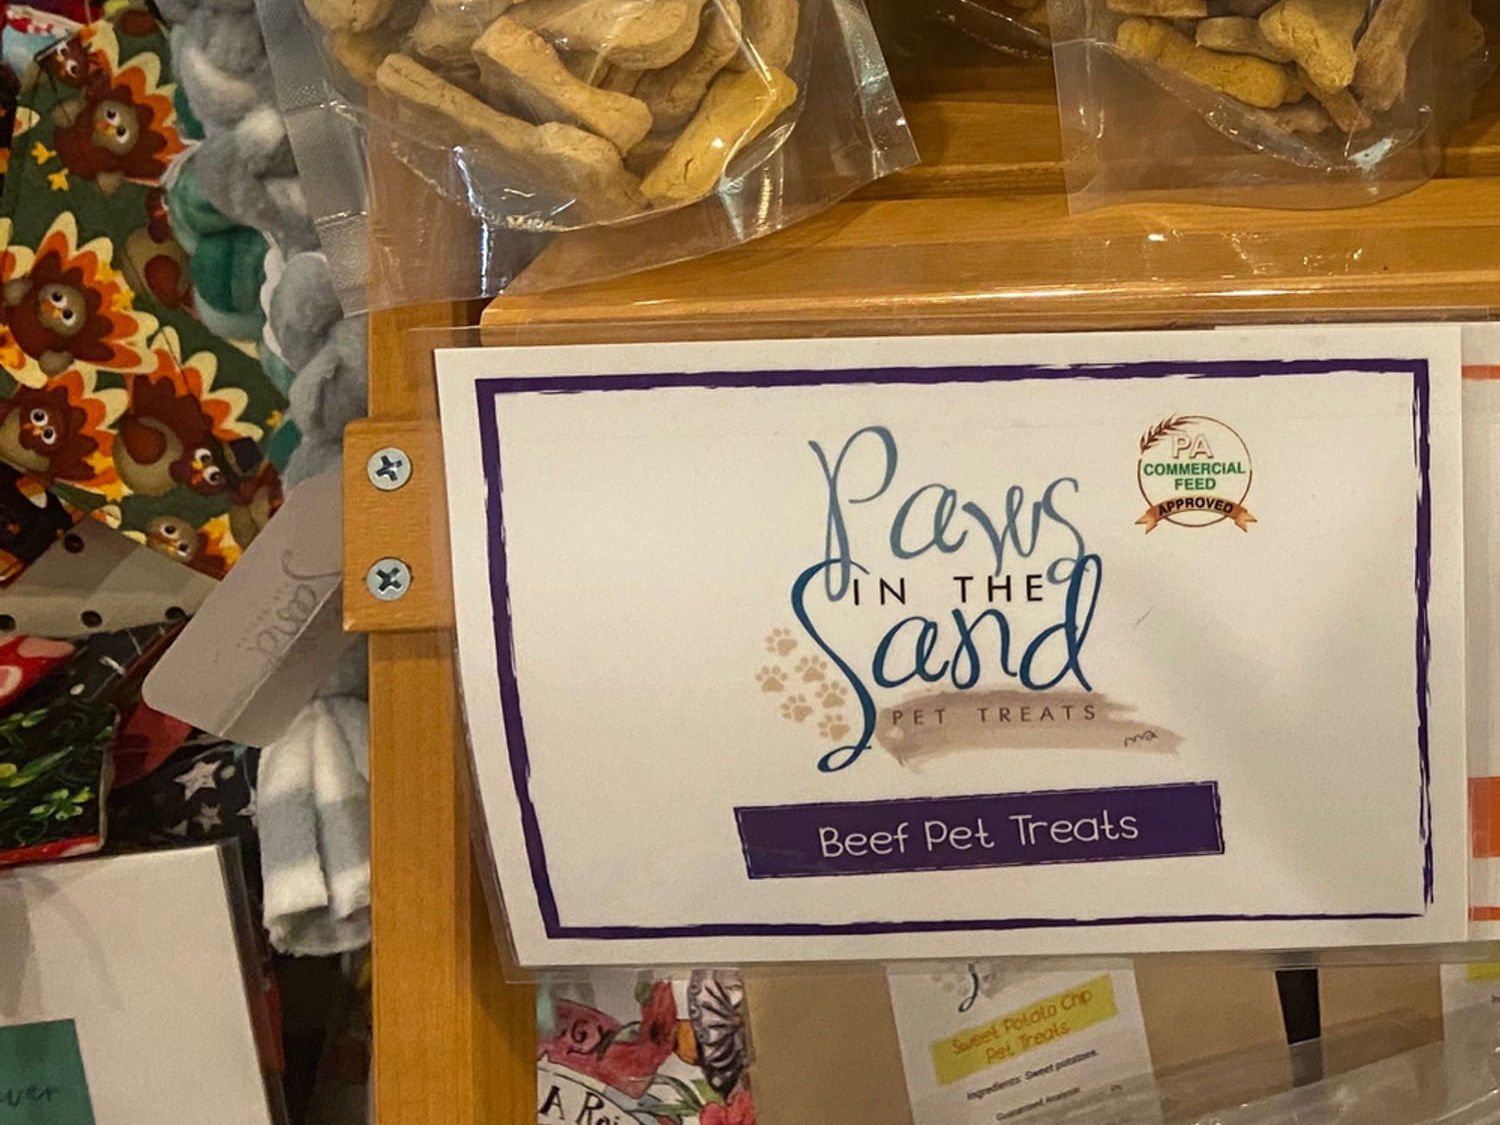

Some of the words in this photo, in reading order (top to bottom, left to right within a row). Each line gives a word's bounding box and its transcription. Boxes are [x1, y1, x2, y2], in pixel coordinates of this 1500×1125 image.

[1172, 430, 1213, 459] PA
[1143, 461, 1246, 478] COMMERCIAL
[1173, 476, 1217, 491] FEED
[808, 425, 1085, 601] Paws
[1156, 496, 1234, 519] APPROVED
[852, 577, 908, 606] IN
[954, 574, 1045, 604] THE
[791, 553, 1103, 773] Sand
[892, 707, 947, 725] PET
[978, 704, 1099, 724] TREATS
[820, 823, 908, 860] Beef
[925, 817, 994, 852] Pet
[1009, 811, 1139, 847] Treats
[952, 1025, 998, 1056] Sweet
[1019, 1021, 1071, 1047] Treats
